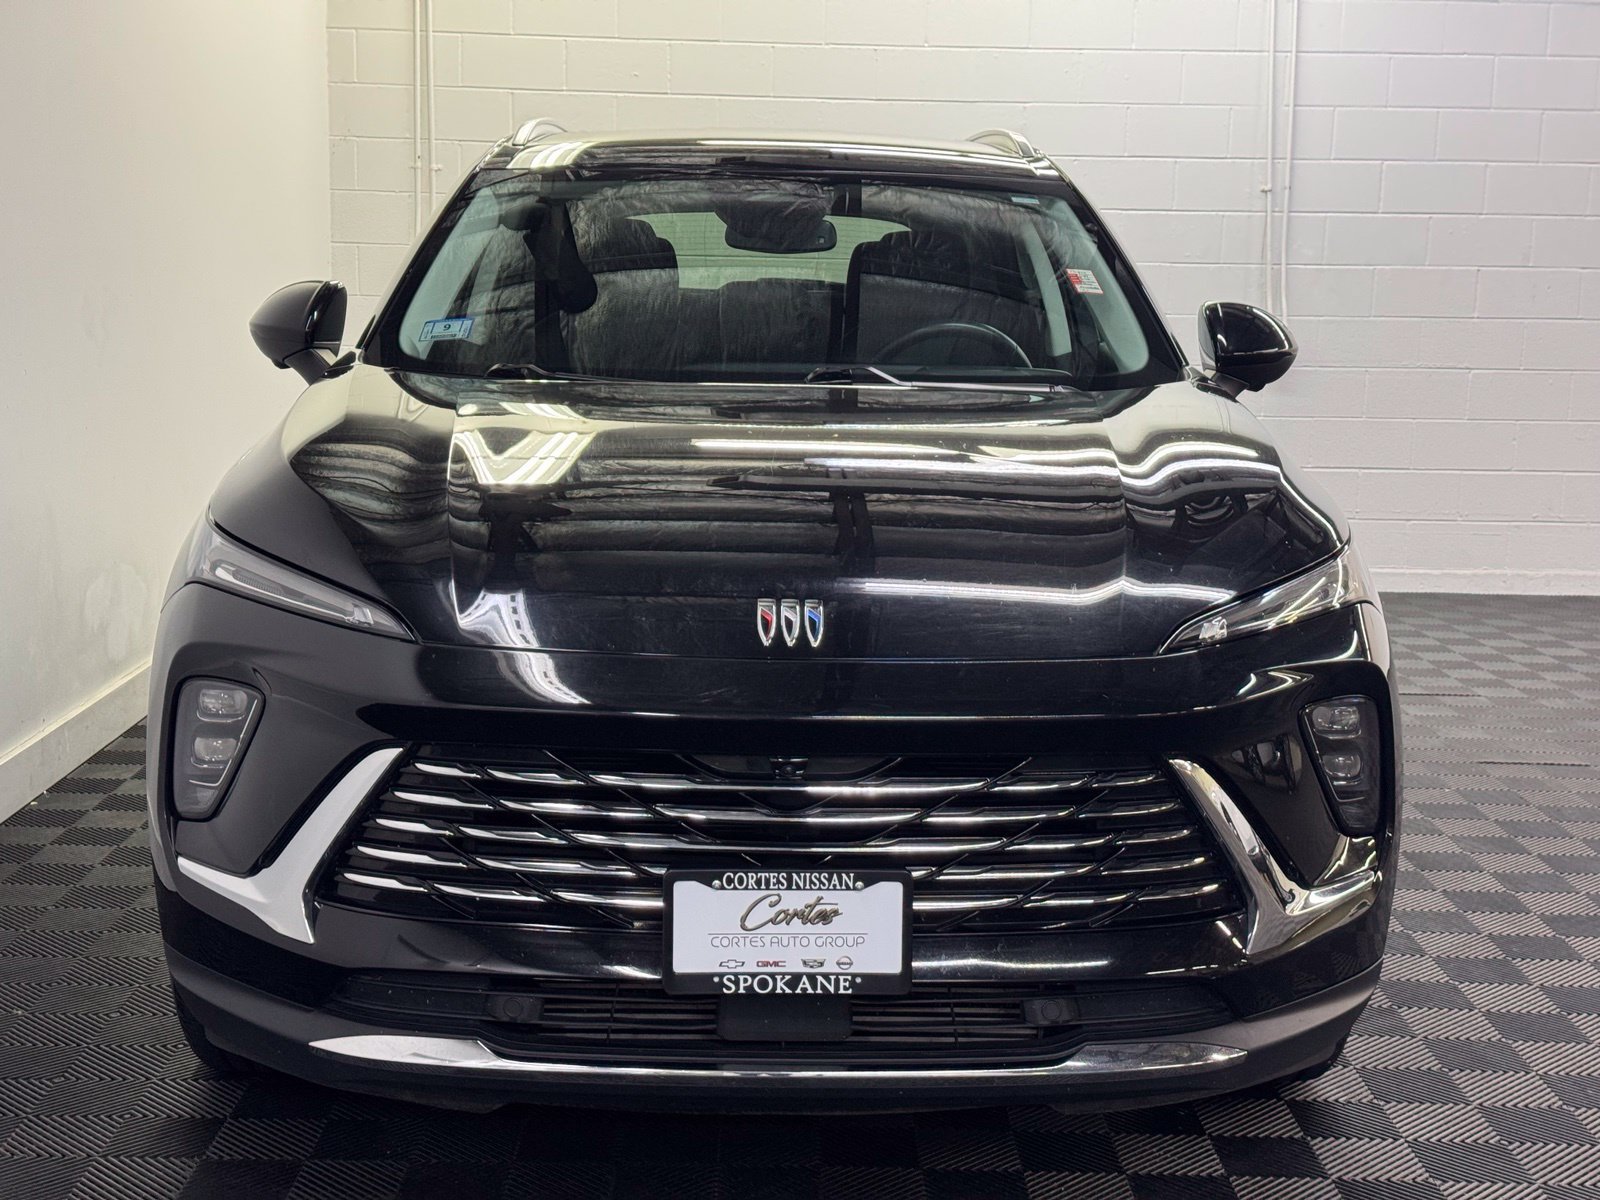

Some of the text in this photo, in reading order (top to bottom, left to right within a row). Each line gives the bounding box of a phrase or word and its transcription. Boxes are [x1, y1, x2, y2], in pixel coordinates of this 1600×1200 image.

[722, 872, 855, 890] CORTES NISSAN
[739, 893, 844, 932] Cortes
[710, 936, 866, 948] CORTES AUTO GROUP
[756, 960, 787, 968] GMC
[722, 974, 853, 994] SPOKANE
